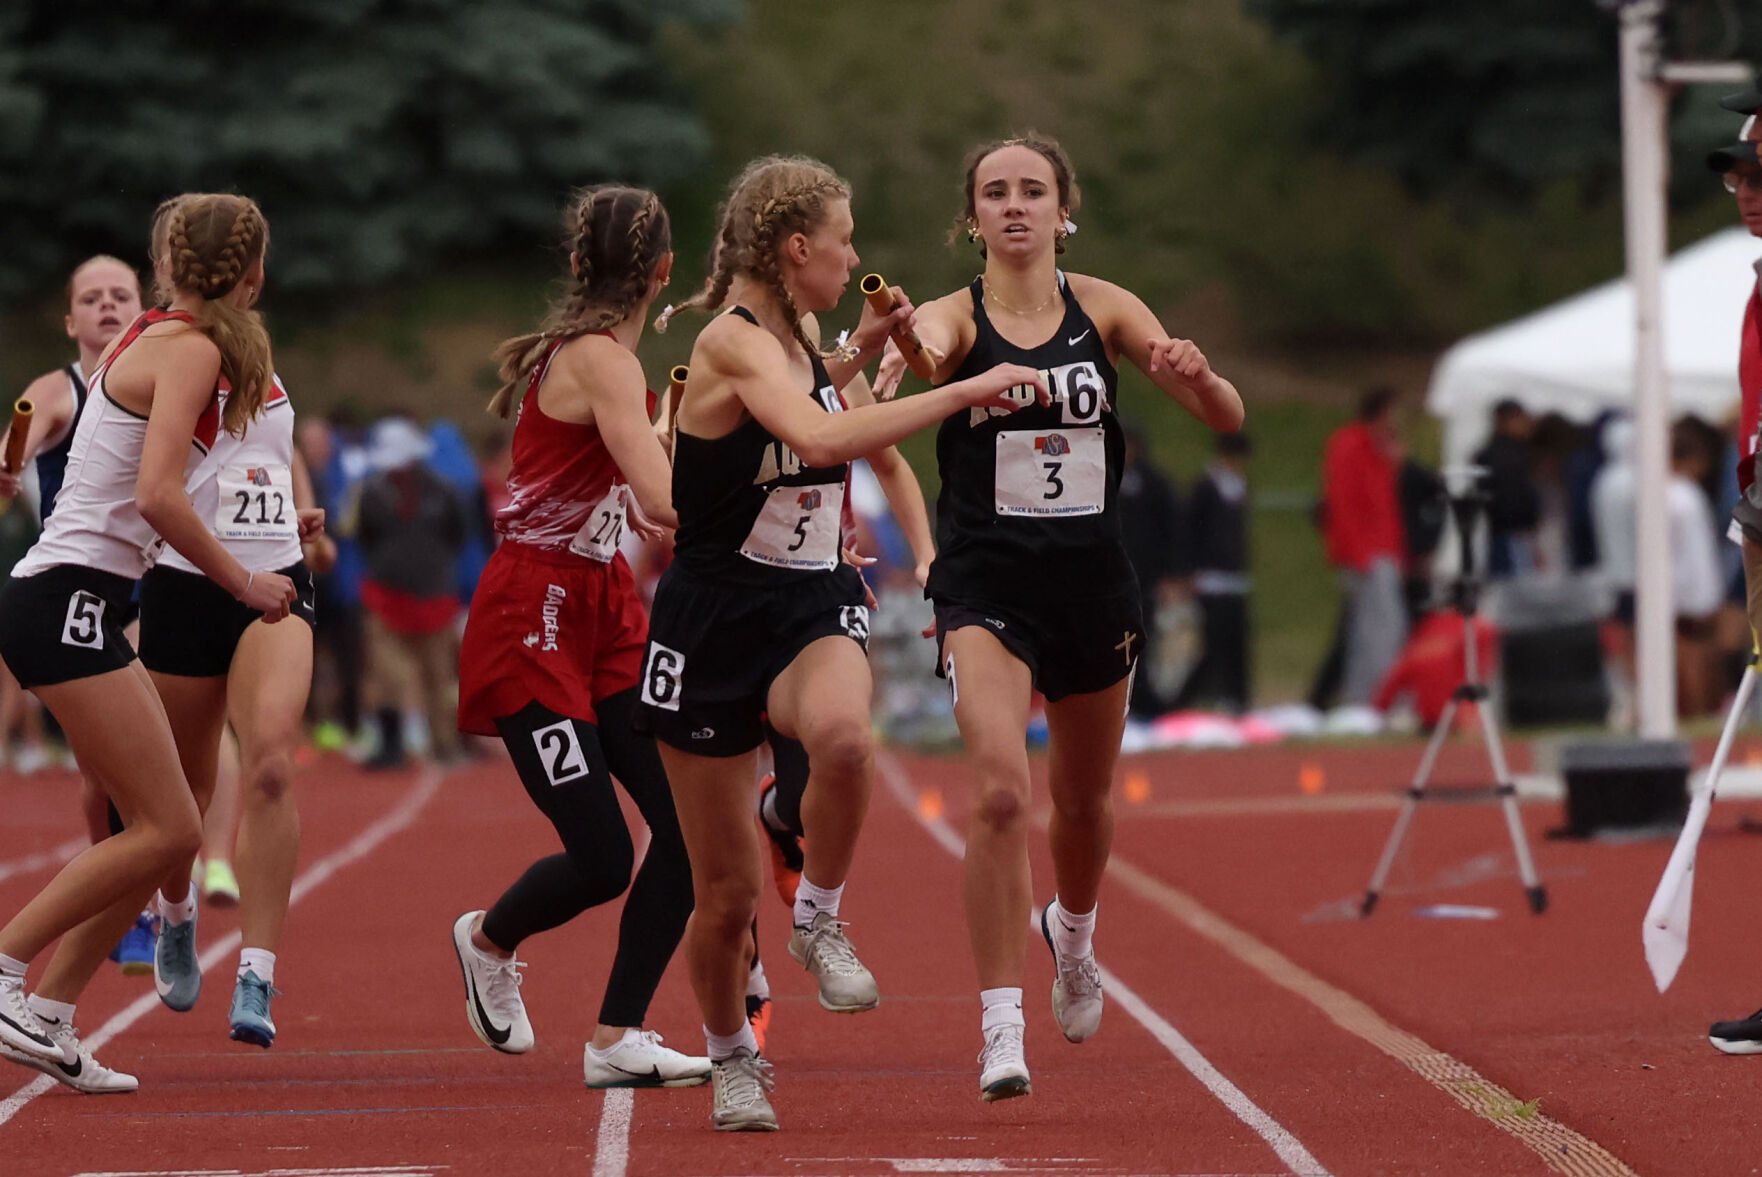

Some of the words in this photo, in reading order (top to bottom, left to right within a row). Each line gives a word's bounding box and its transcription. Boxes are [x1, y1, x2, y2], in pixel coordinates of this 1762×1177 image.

[1066, 366, 1098, 419] 6
[1043, 462, 1064, 500] 3
[233, 490, 286, 524] 212
[787, 515, 811, 551] 5
[70, 593, 100, 643] 5
[542, 584, 566, 651] BADGERS
[648, 649, 677, 703] 6
[540, 727, 581, 781] 2
